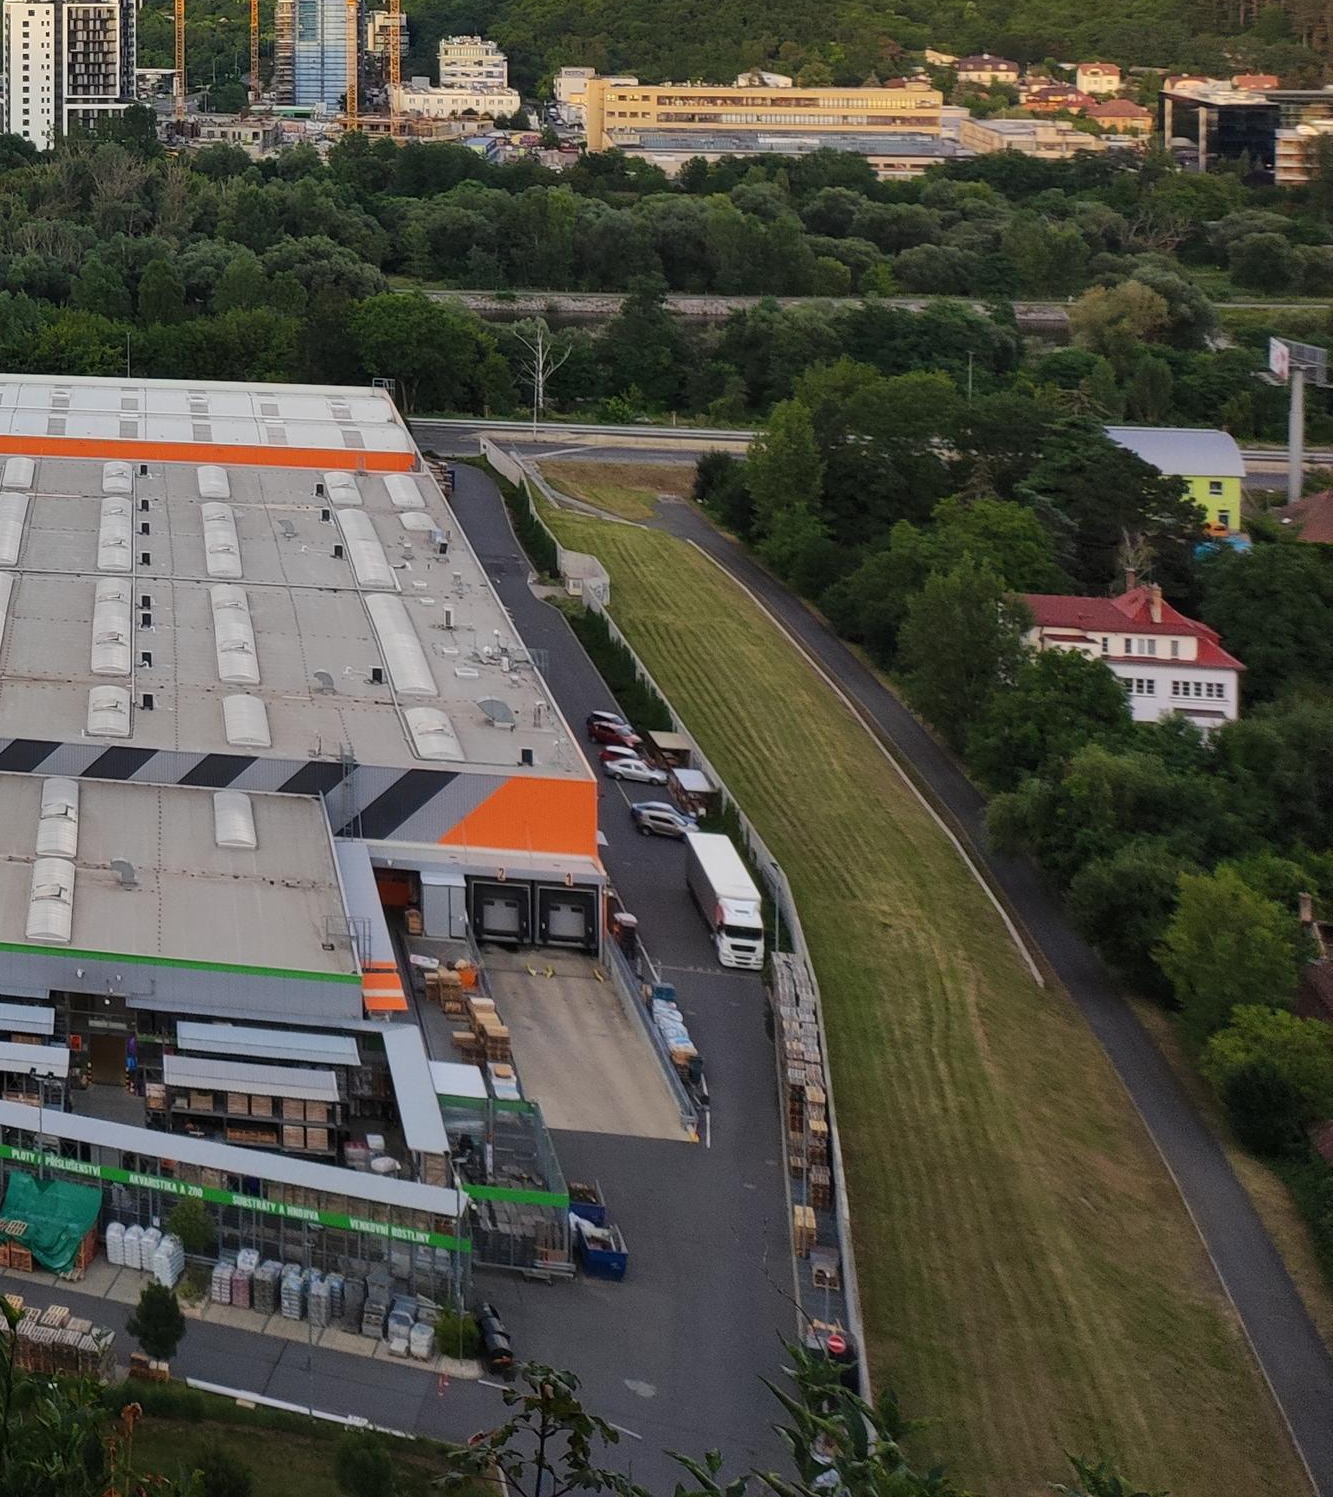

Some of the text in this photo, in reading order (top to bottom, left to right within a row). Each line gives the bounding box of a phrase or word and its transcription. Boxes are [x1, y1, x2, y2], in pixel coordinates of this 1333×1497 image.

[498, 867, 506, 880] 2
[11, 1148, 35, 1164] PLOTY
[129, 1174, 203, 1198] AKVARISTIKA A ZOO
[278, 1204, 286, 1215] A
[349, 1216, 431, 1244] VENKOVNÍ ROSTLINY
